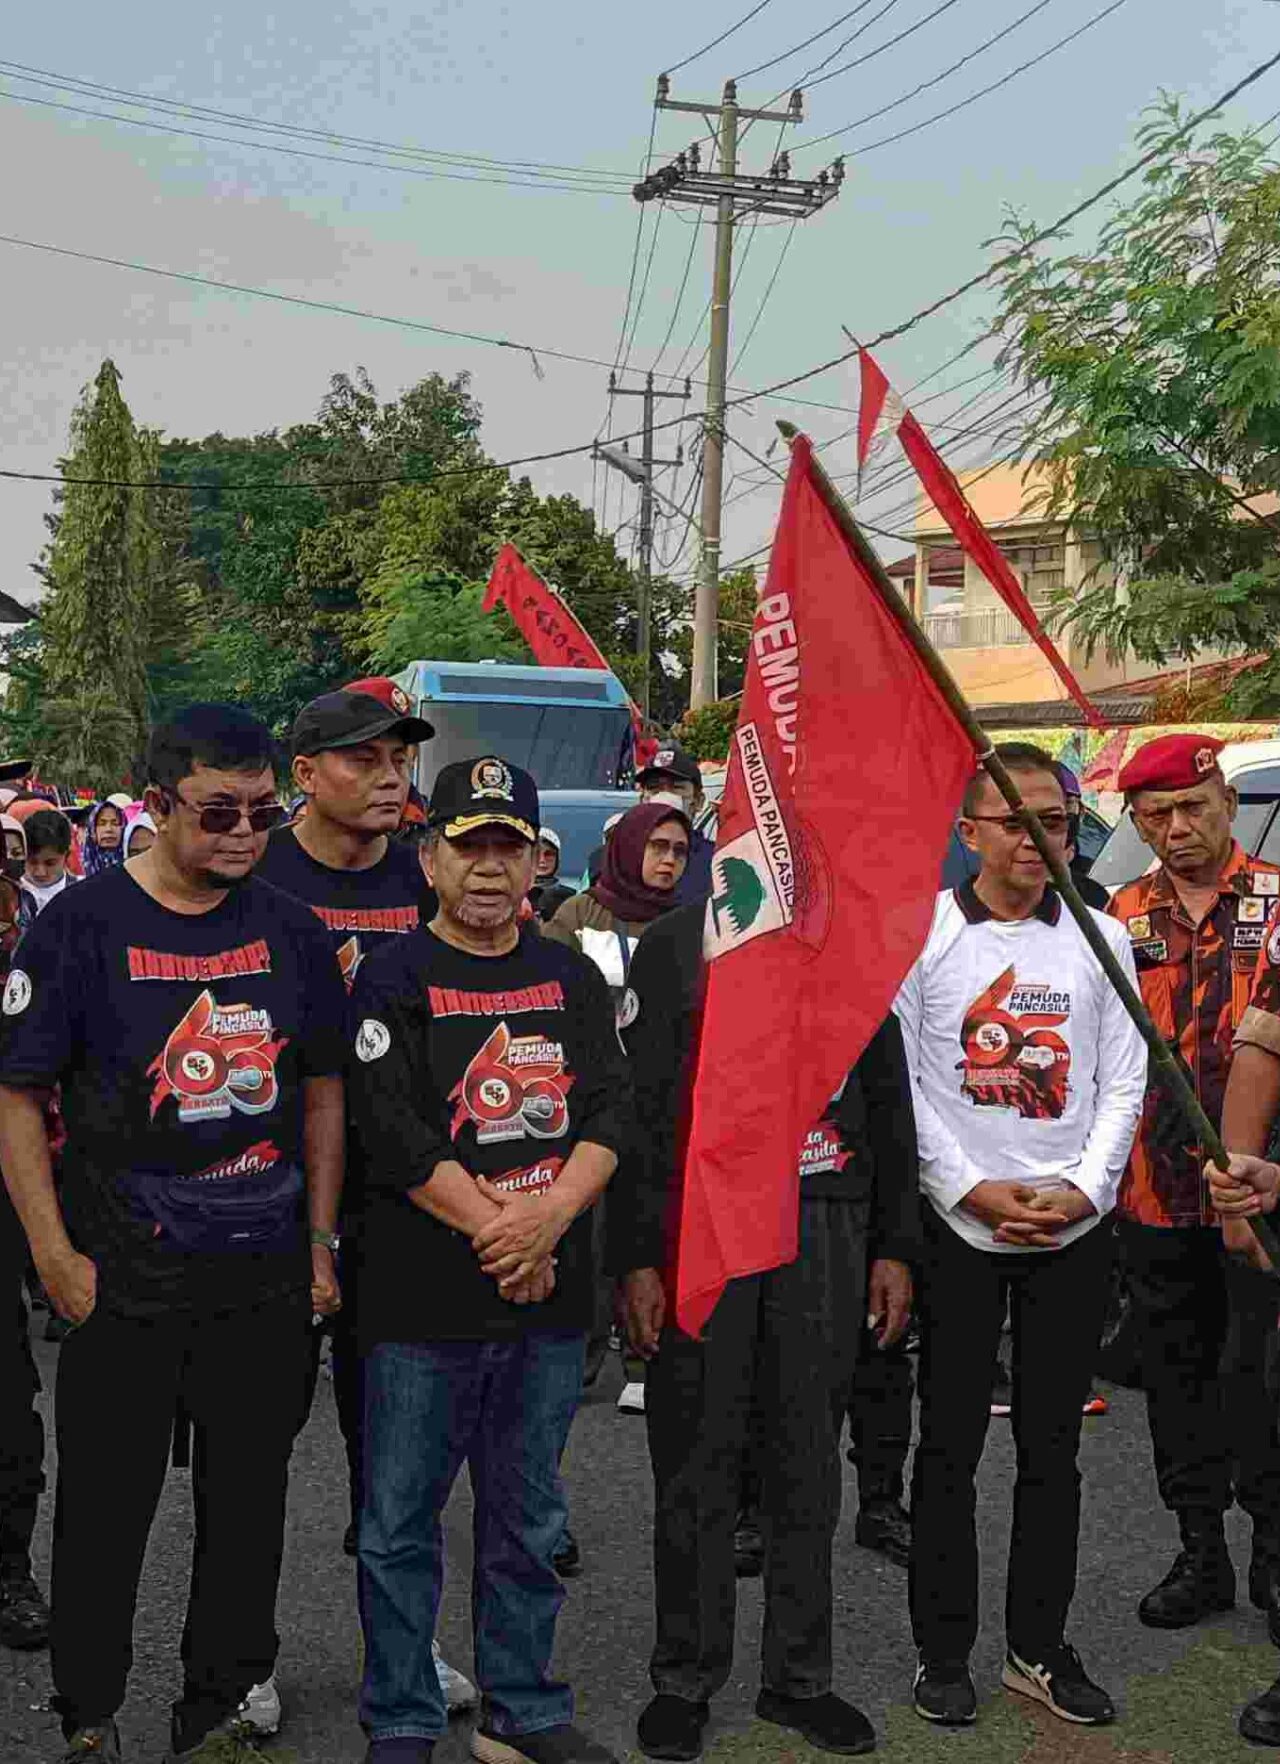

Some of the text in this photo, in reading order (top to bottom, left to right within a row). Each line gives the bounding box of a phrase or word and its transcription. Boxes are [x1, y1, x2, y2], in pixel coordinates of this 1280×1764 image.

[740, 727, 772, 808] PEMUDA
[1010, 992, 1071, 1004] PEMUDA
[1008, 1002, 1071, 1013] PANCASILA
[212, 1009, 267, 1026] PEMUDA
[508, 1043, 563, 1057] PEMUDA
[508, 1052, 565, 1065] PANCASILA
